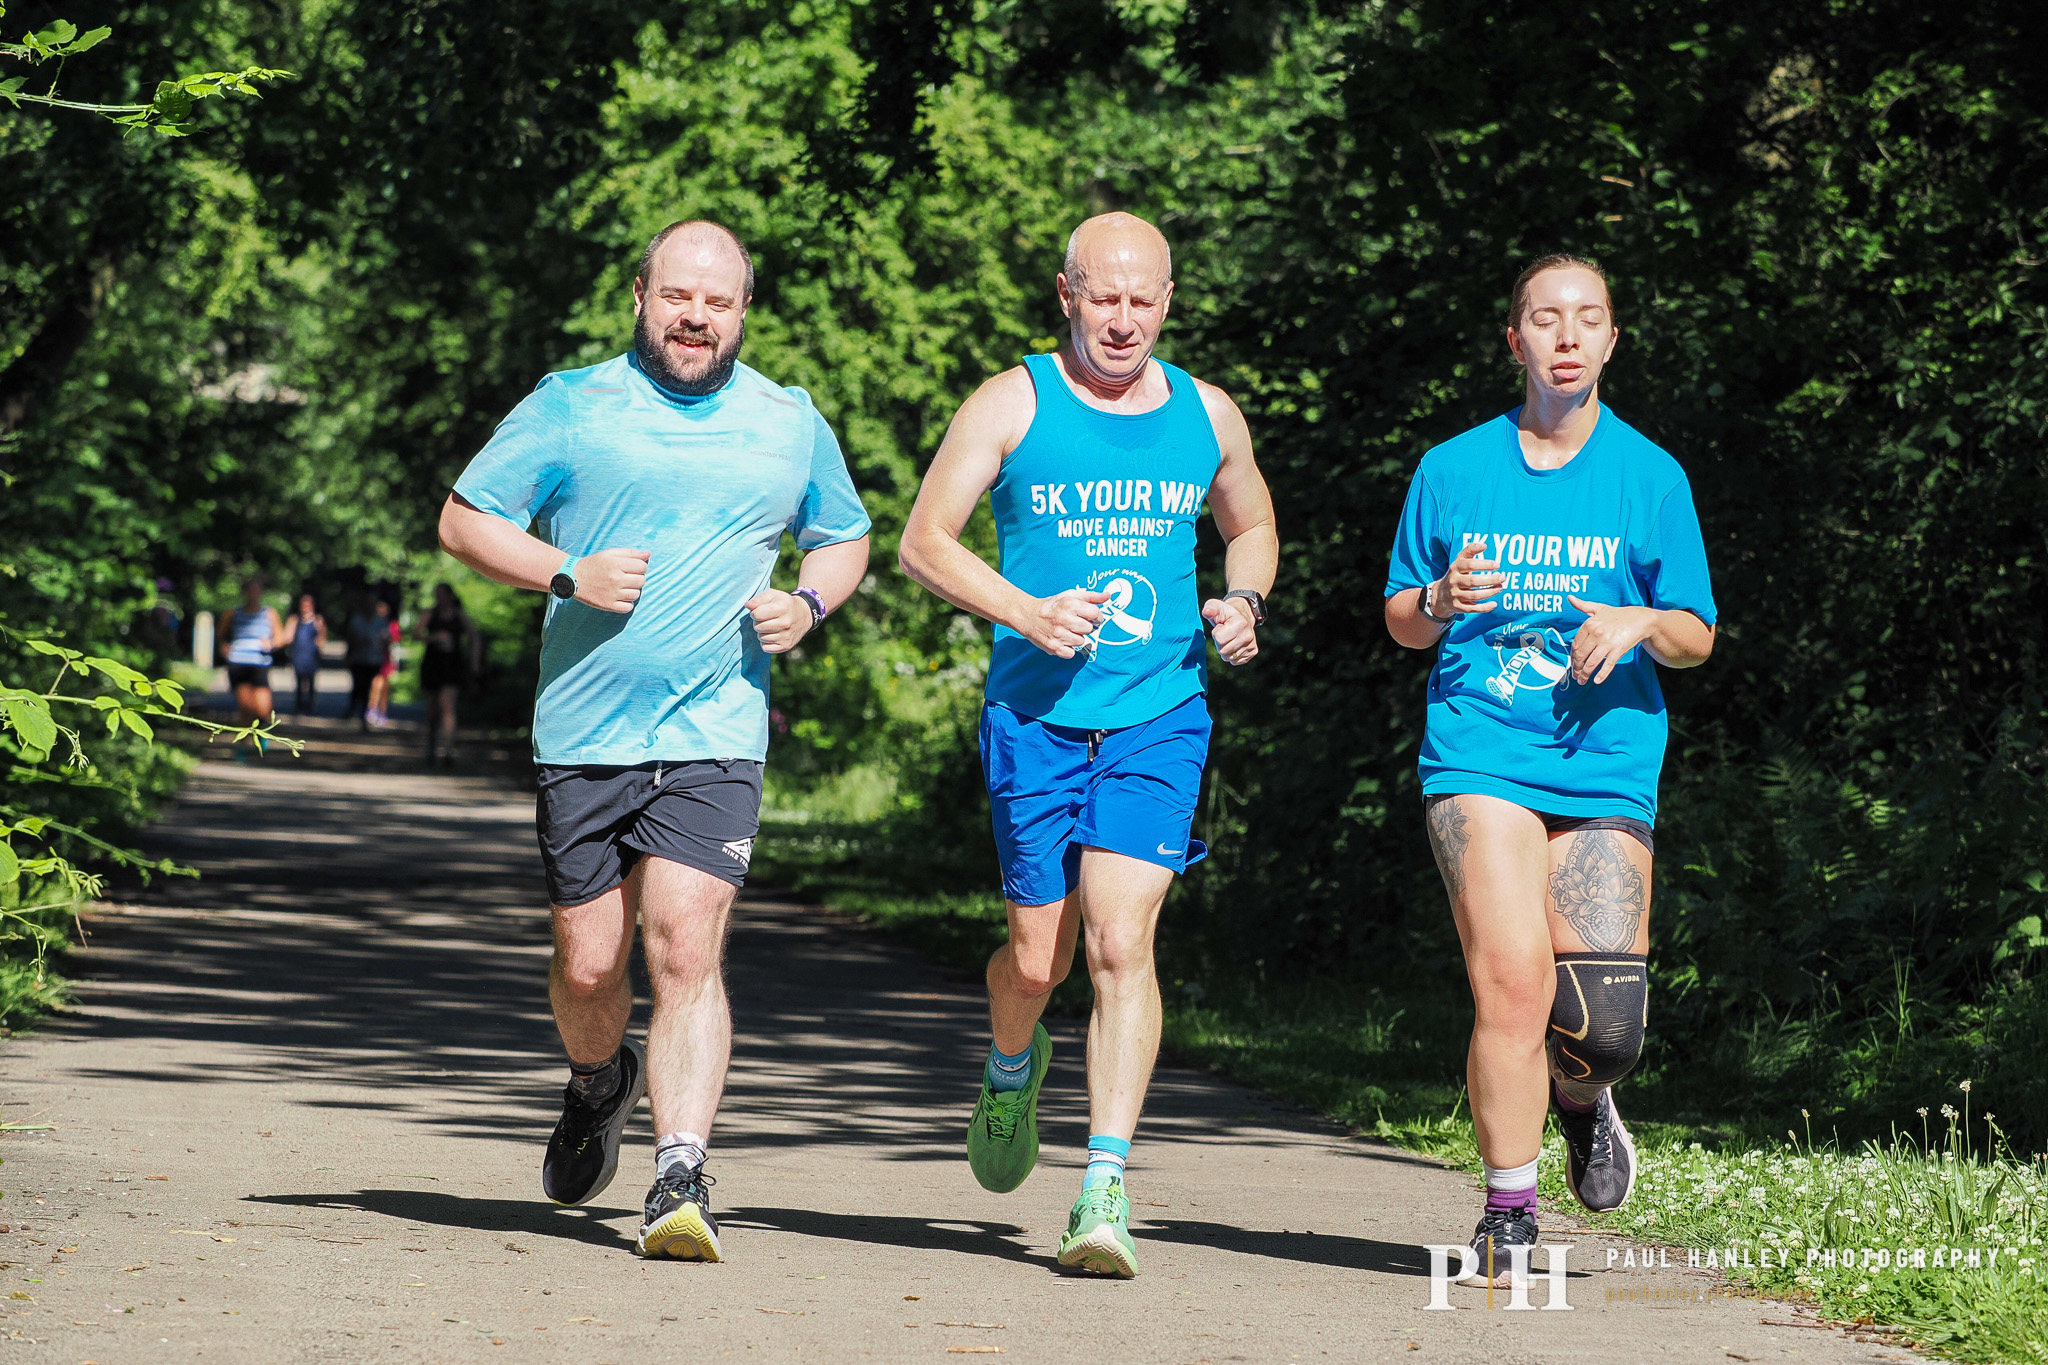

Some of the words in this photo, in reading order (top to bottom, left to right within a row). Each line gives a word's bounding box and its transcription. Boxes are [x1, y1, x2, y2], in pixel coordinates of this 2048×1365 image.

[1031, 483, 1068, 515] 5K
[1075, 480, 1153, 513] YOUR
[1160, 481, 1206, 516] WAY
[1058, 518, 1104, 538] MOVE
[1108, 517, 1175, 537] AGAINST
[1086, 538, 1148, 557] CANCER
[1493, 533, 1562, 566] YOUR
[1567, 536, 1621, 569] WAY
[1087, 568, 1120, 589] Your
[1523, 572, 1590, 593] AGAINST
[1503, 592, 1563, 613] CANCER
[1503, 621, 1530, 637] Your
[1501, 644, 1544, 688] MOVE
[722, 847, 739, 860] NIKE
